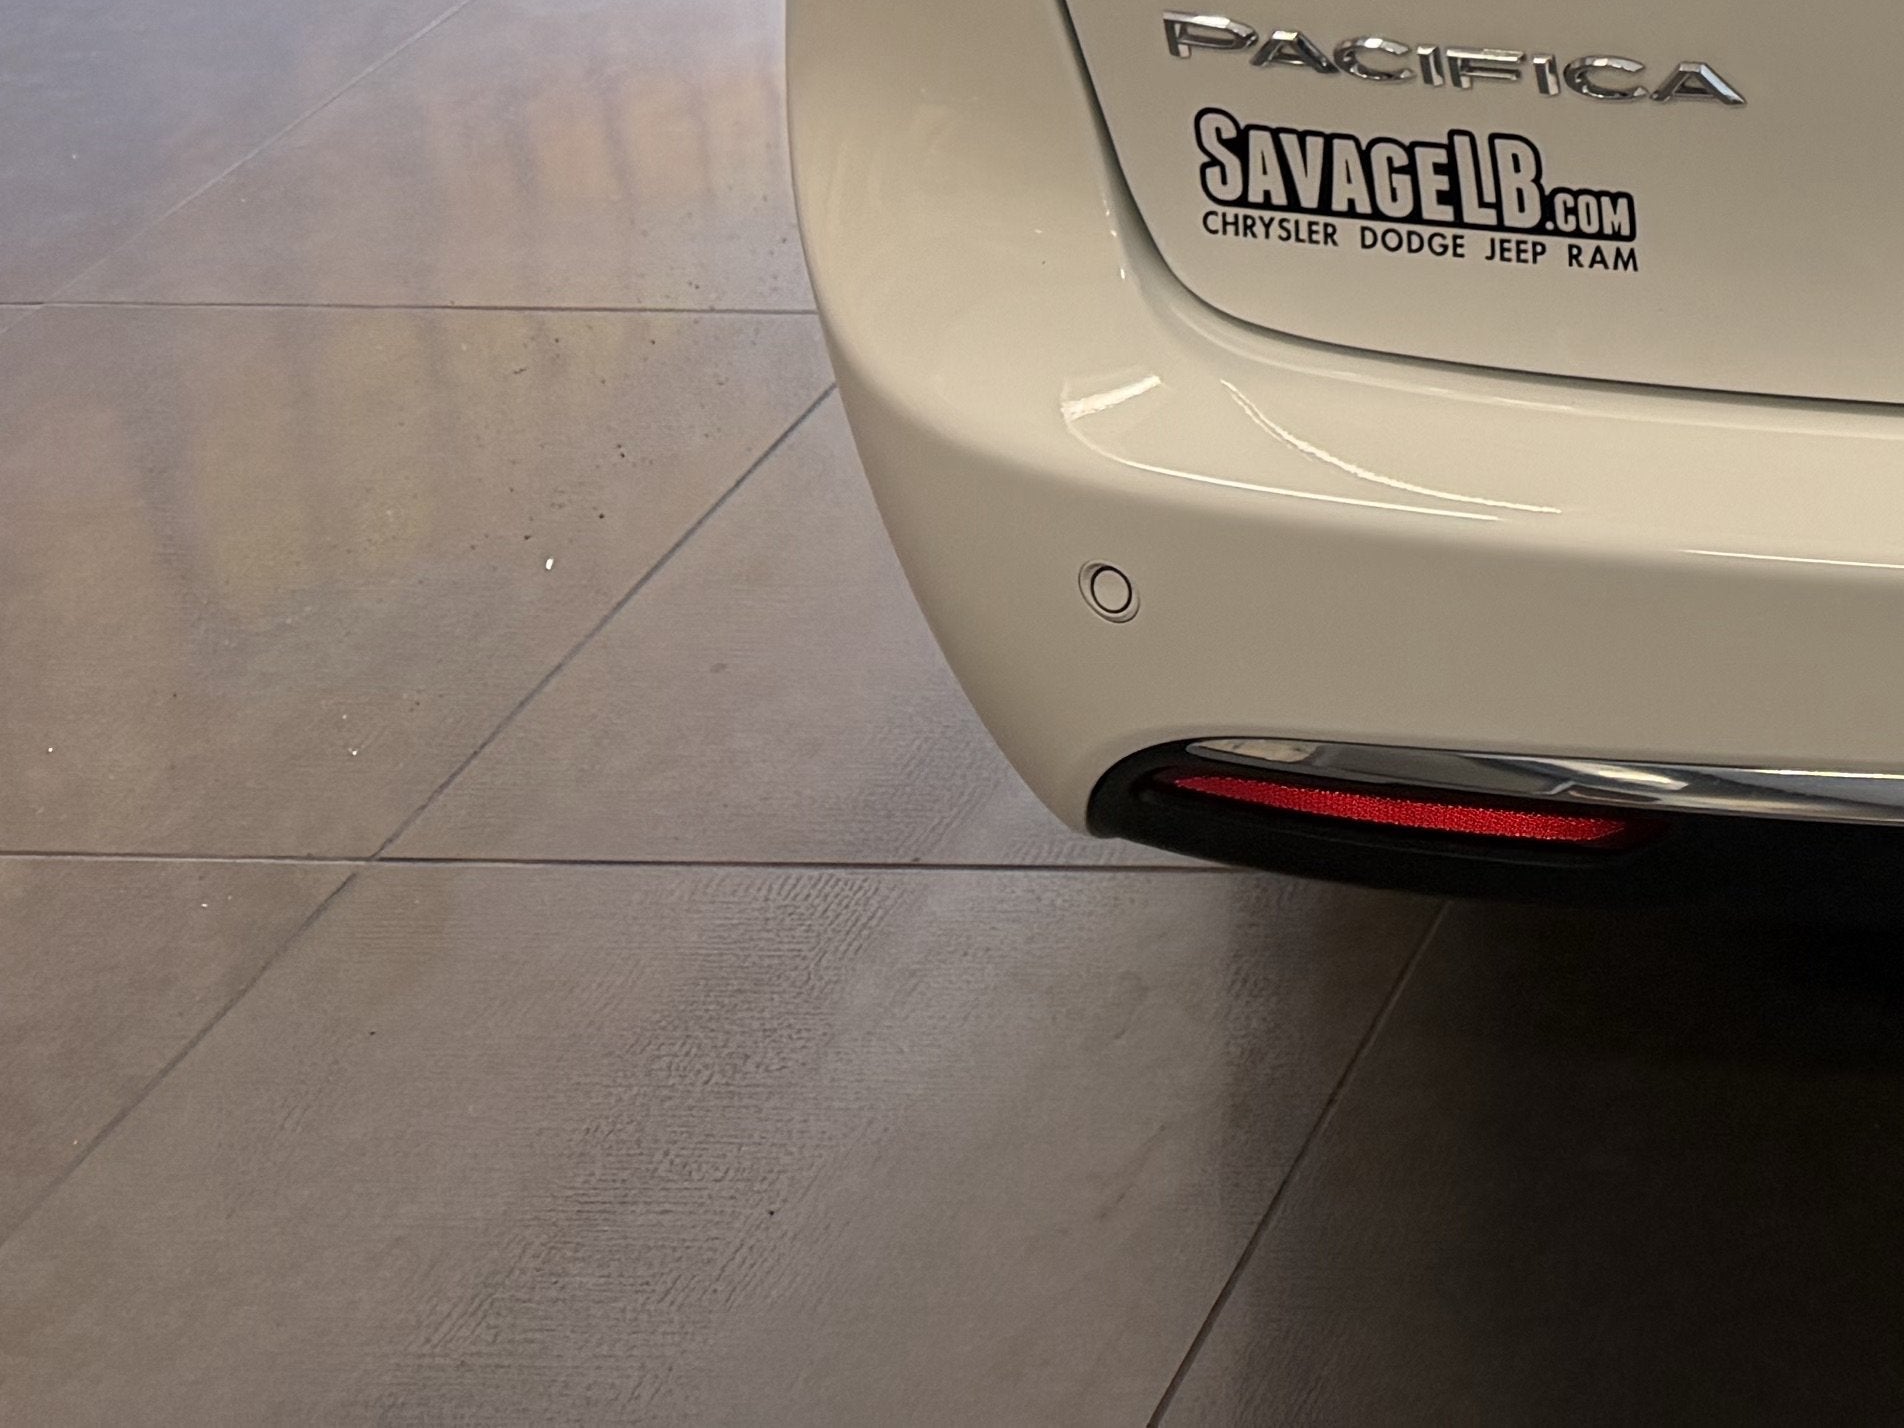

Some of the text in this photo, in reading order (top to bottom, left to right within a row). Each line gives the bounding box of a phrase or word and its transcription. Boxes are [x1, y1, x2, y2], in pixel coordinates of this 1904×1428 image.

[1162, 9, 1748, 107] PACIFICA
[1202, 210, 1639, 273] CHRYSLER DODGE JEEP RAM
